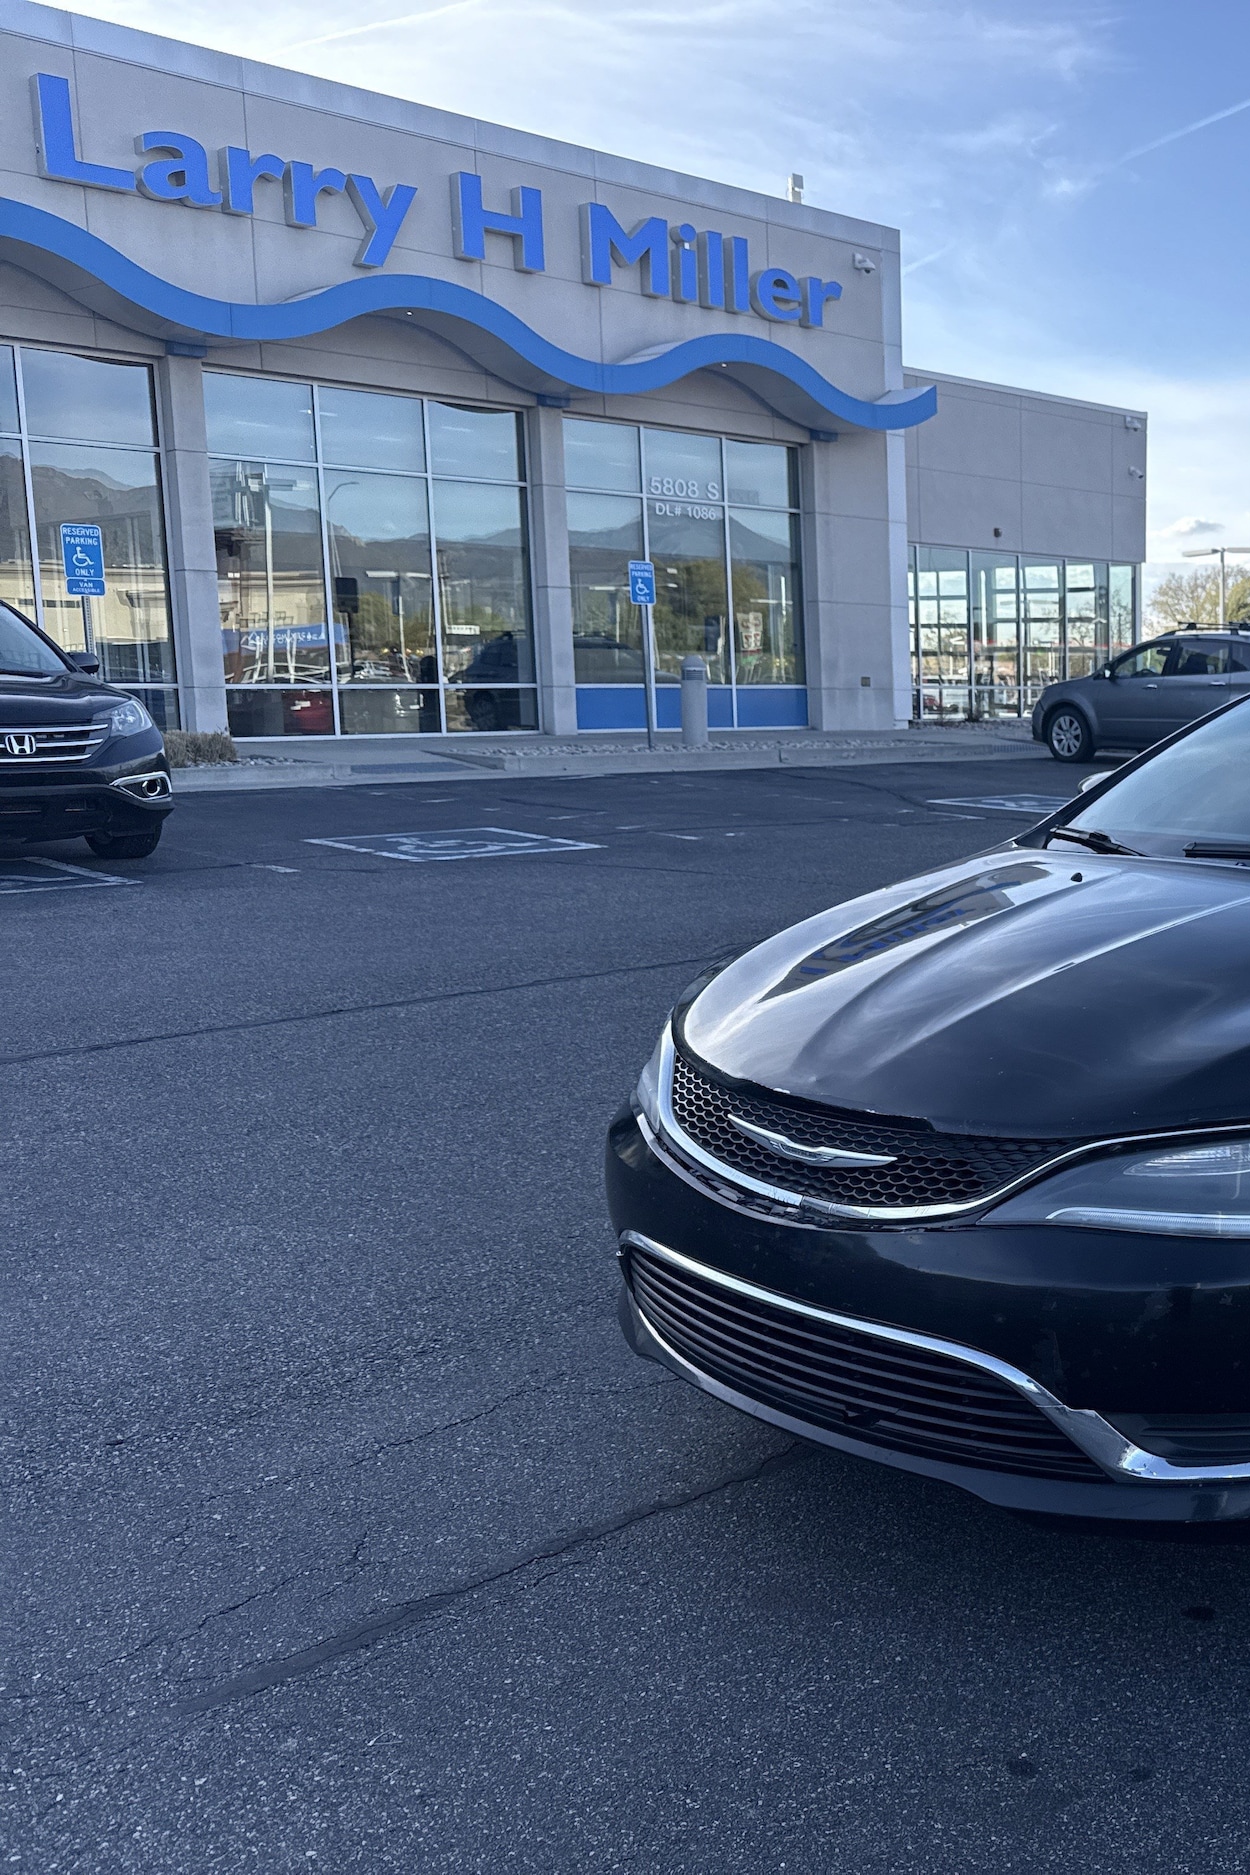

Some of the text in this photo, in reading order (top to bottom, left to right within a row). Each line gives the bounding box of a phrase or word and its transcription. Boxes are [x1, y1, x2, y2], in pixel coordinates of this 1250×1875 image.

[31, 72, 843, 327] Larry H Miller
[650, 476, 719, 500] 5808 S
[655, 502, 716, 520] DL# 1086
[62, 527, 99, 537] RESERVED
[65, 536, 98, 546] PARKING
[75, 568, 95, 577] ONLY
